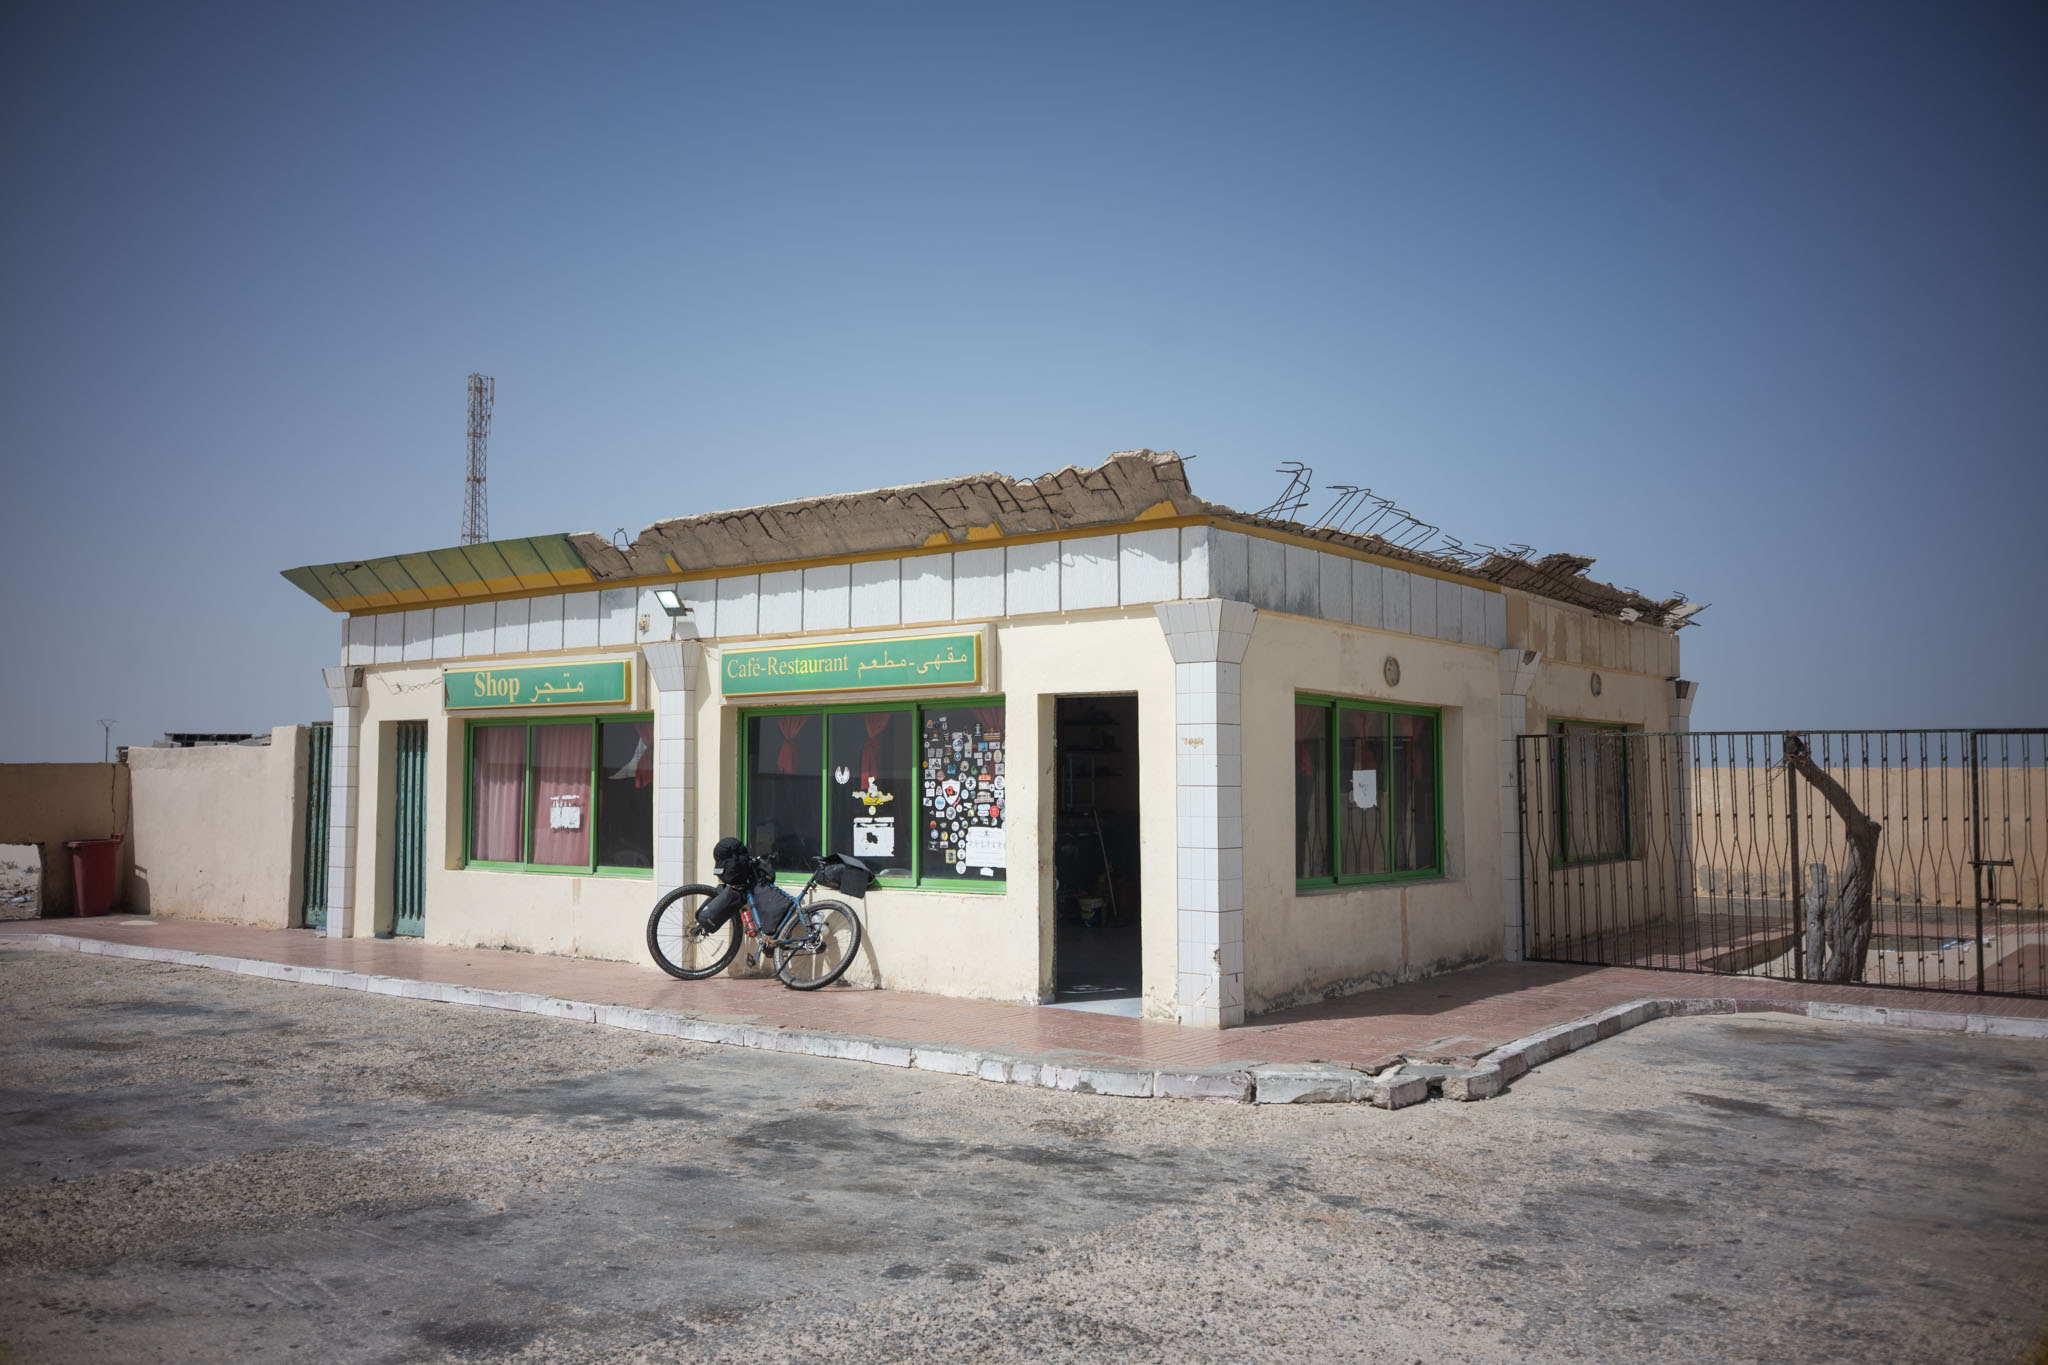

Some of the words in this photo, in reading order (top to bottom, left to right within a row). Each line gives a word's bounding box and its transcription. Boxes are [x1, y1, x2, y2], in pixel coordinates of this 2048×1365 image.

[727, 654, 848, 679] Café-Restaurant
[474, 672, 519, 702] Shop
[530, 672, 583, 702] متجر
